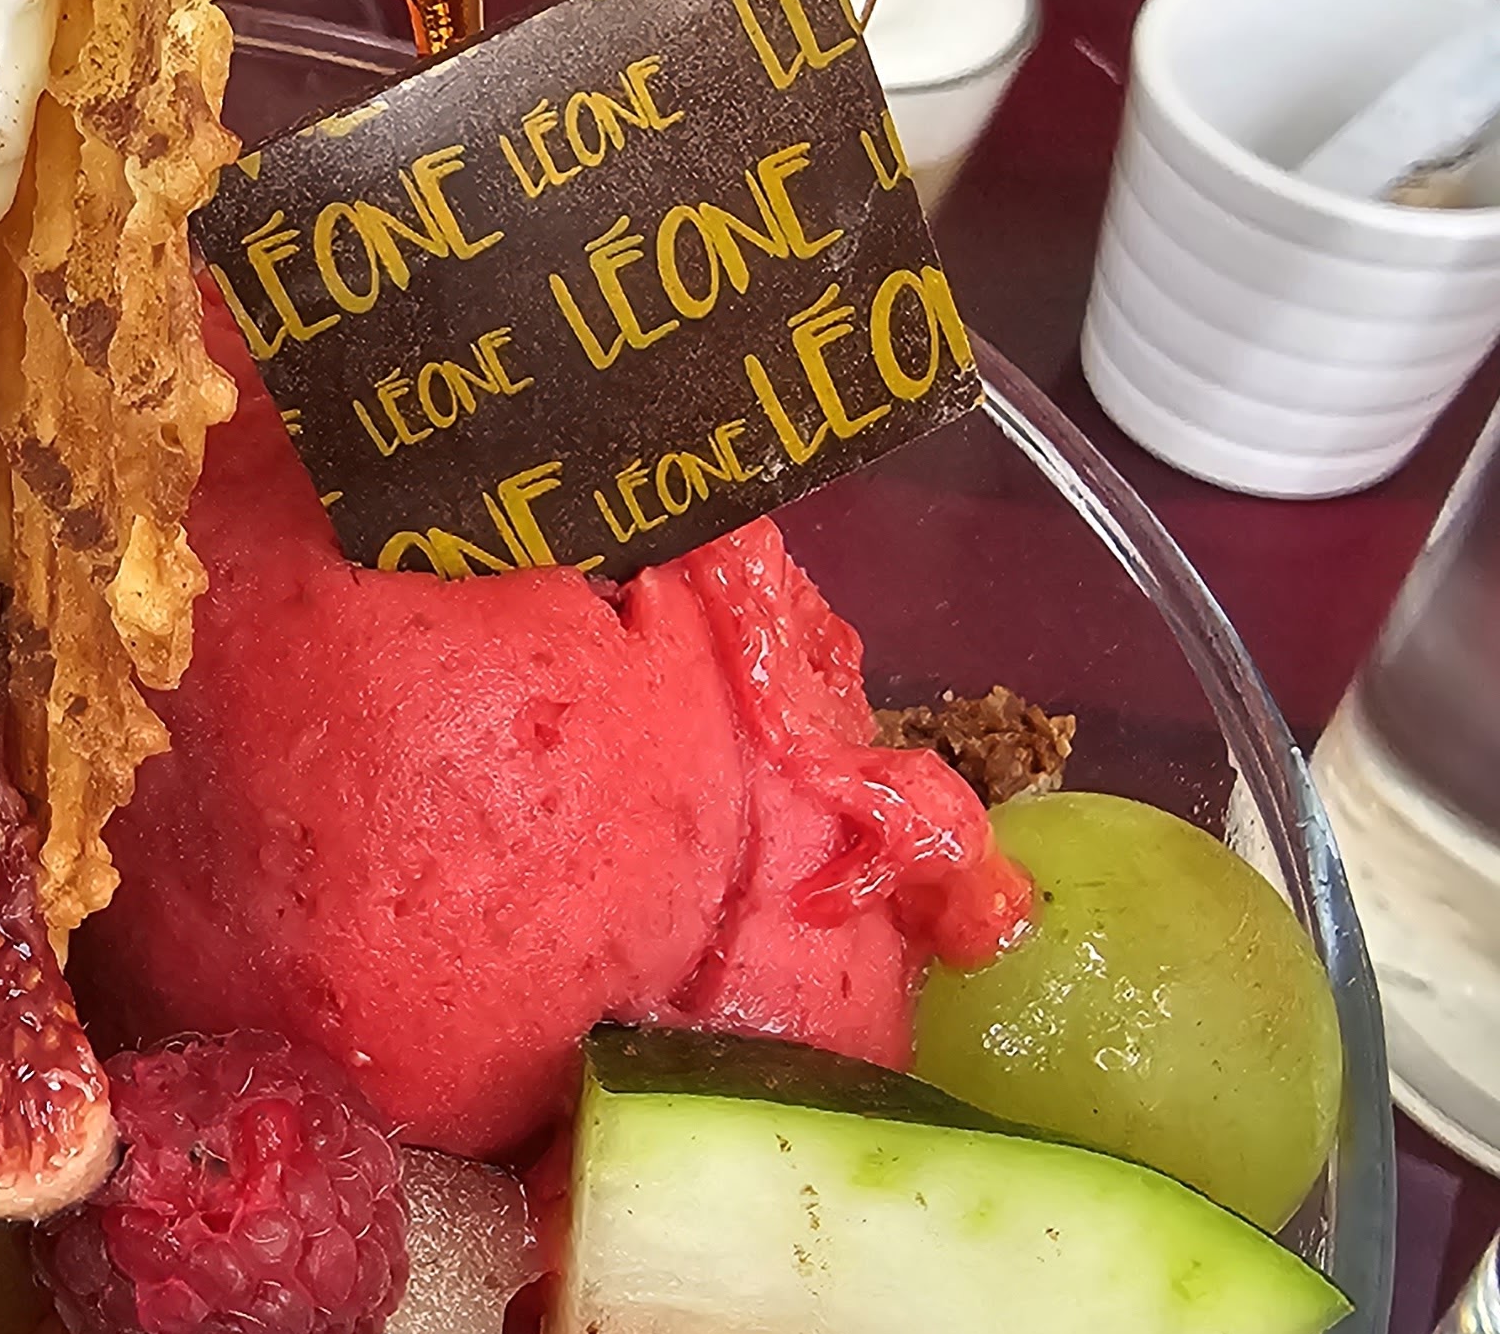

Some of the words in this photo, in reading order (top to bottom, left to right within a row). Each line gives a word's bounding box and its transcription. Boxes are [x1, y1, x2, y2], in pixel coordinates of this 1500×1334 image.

[209, 145, 505, 361] LÉONE
[499, 54, 684, 199] LÉONE
[352, 327, 535, 456] LÉONE
[548, 142, 844, 371] LÉONE
[593, 419, 765, 543] LÉONE
